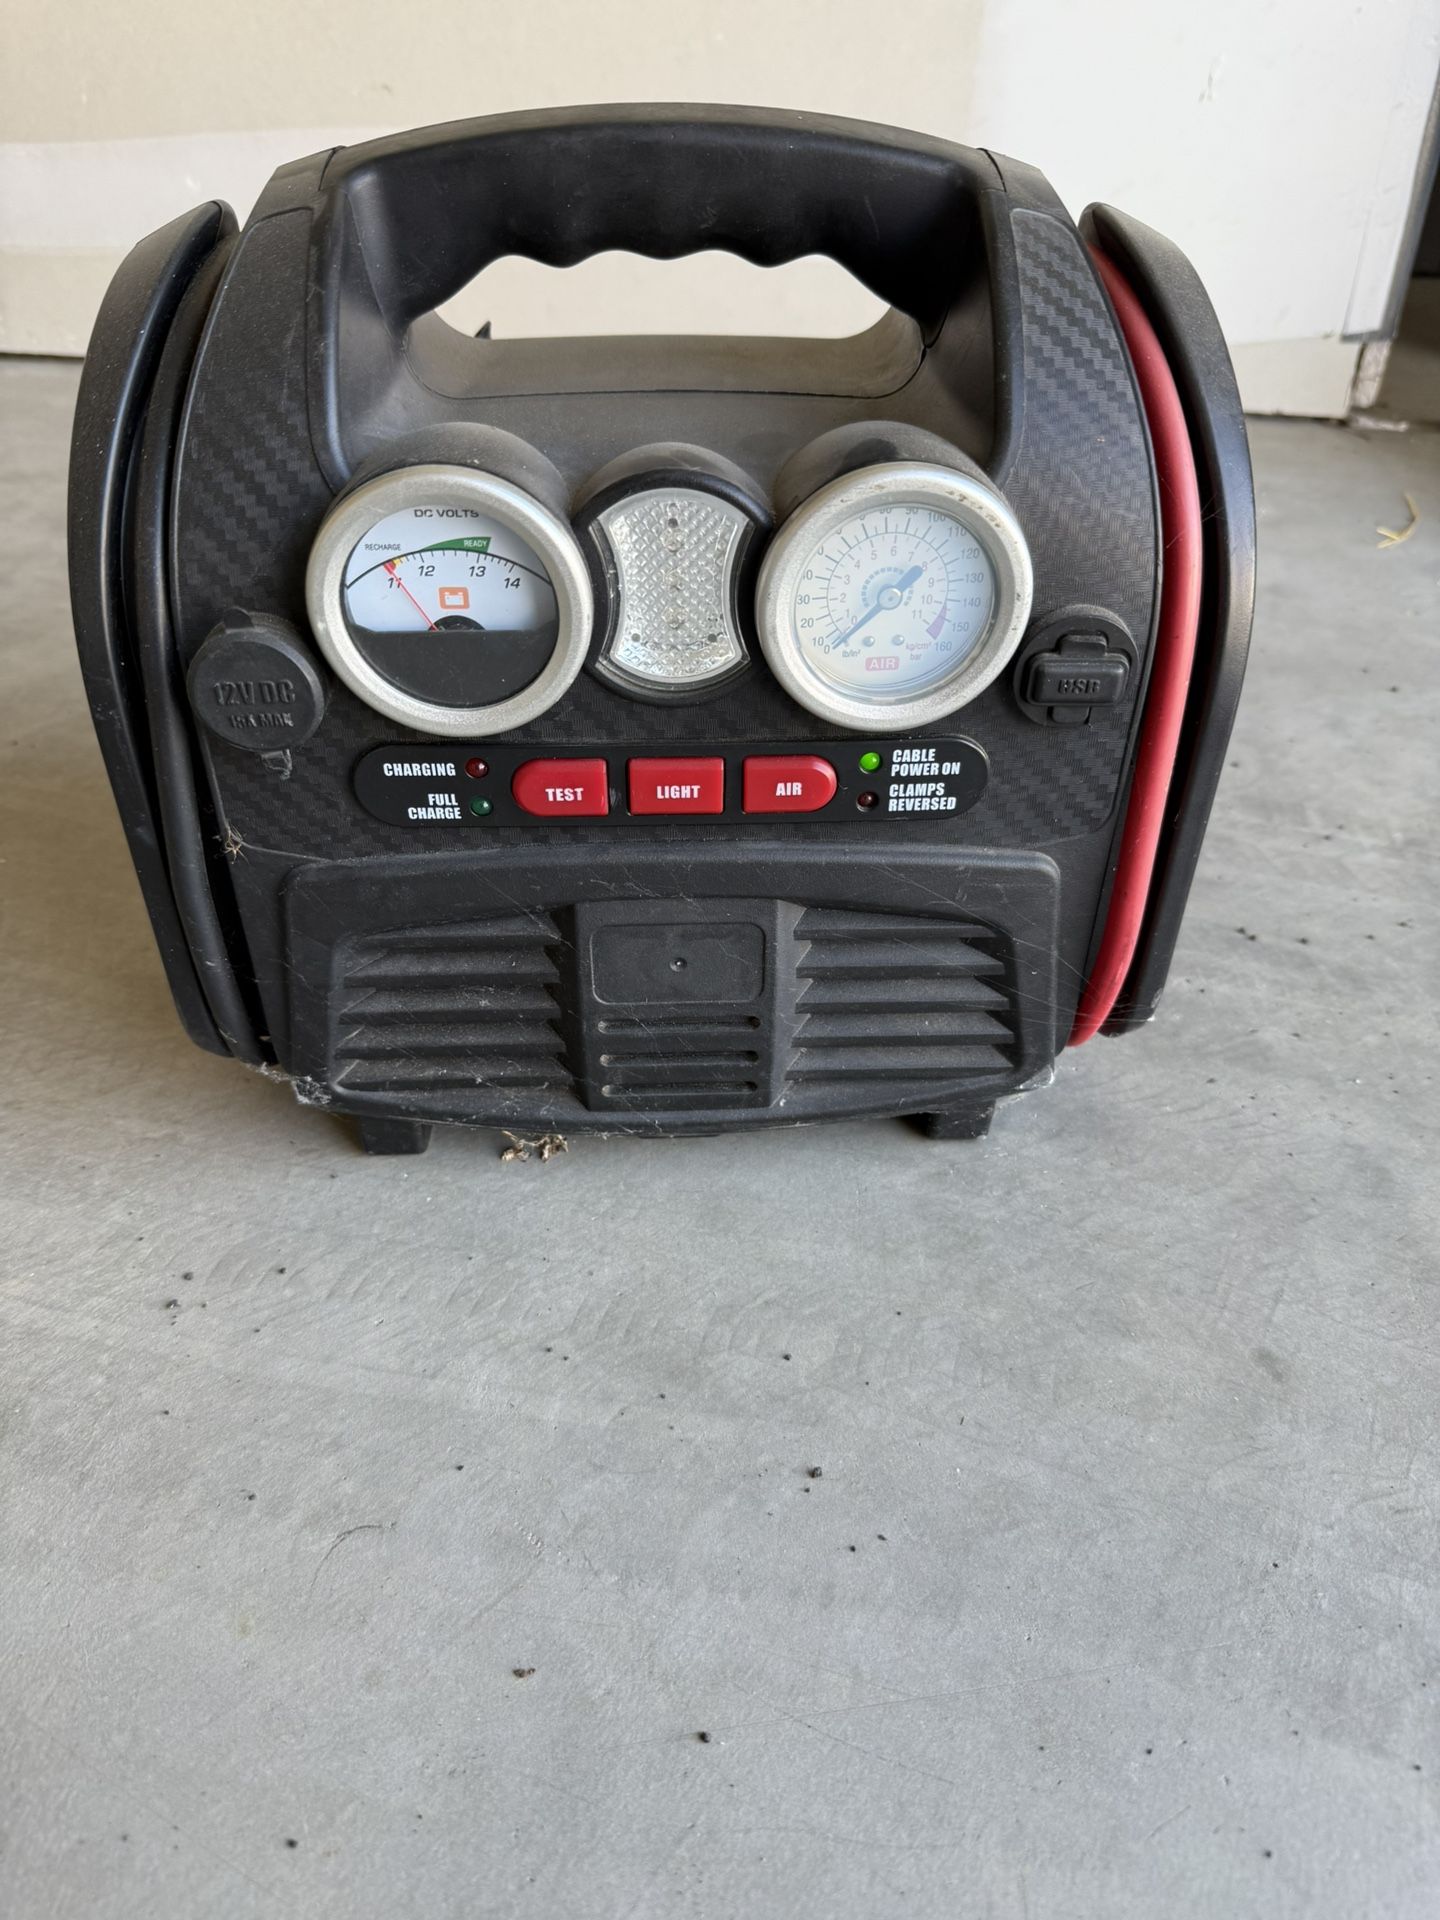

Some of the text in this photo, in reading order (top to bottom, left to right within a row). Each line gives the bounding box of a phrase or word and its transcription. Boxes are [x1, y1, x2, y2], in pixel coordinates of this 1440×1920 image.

[414, 509, 479, 518] DC VOLTS
[870, 549, 877, 560] 5
[890, 546, 897, 556] 6
[908, 551, 914, 562] 7
[961, 547, 980, 559] 120
[854, 560, 860, 569] 4
[418, 565, 435, 577] 12
[469, 565, 486, 577] 13
[387, 577, 402, 589] 11
[504, 577, 521, 589] 14
[844, 574, 850, 585] 3
[928, 577, 934, 588] 9
[965, 572, 984, 583] 130
[797, 594, 810, 605] 30
[840, 592, 846, 603] 2
[921, 594, 933, 605] 10
[963, 597, 981, 608] 140
[912, 609, 922, 619] 11
[801, 618, 814, 628] 20
[952, 622, 969, 632] 150
[812, 636, 824, 647] 10
[935, 641, 953, 652] 160
[824, 644, 831, 655] 0
[869, 657, 896, 669] AIR
[260, 679, 296, 703] DC
[1058, 679, 1101, 694] USB
[892, 749, 936, 763] CABLE
[383, 763, 457, 777] CHARGING
[891, 762, 961, 777] POWER ON
[545, 788, 584, 802] TEST
[656, 785, 701, 799] LIGHT
[776, 782, 803, 797] AIR
[889, 783, 945, 797] CLAMPS
[428, 794, 459, 806] FULL
[888, 797, 957, 812] REVERSED
[408, 807, 462, 820] CHARGE
